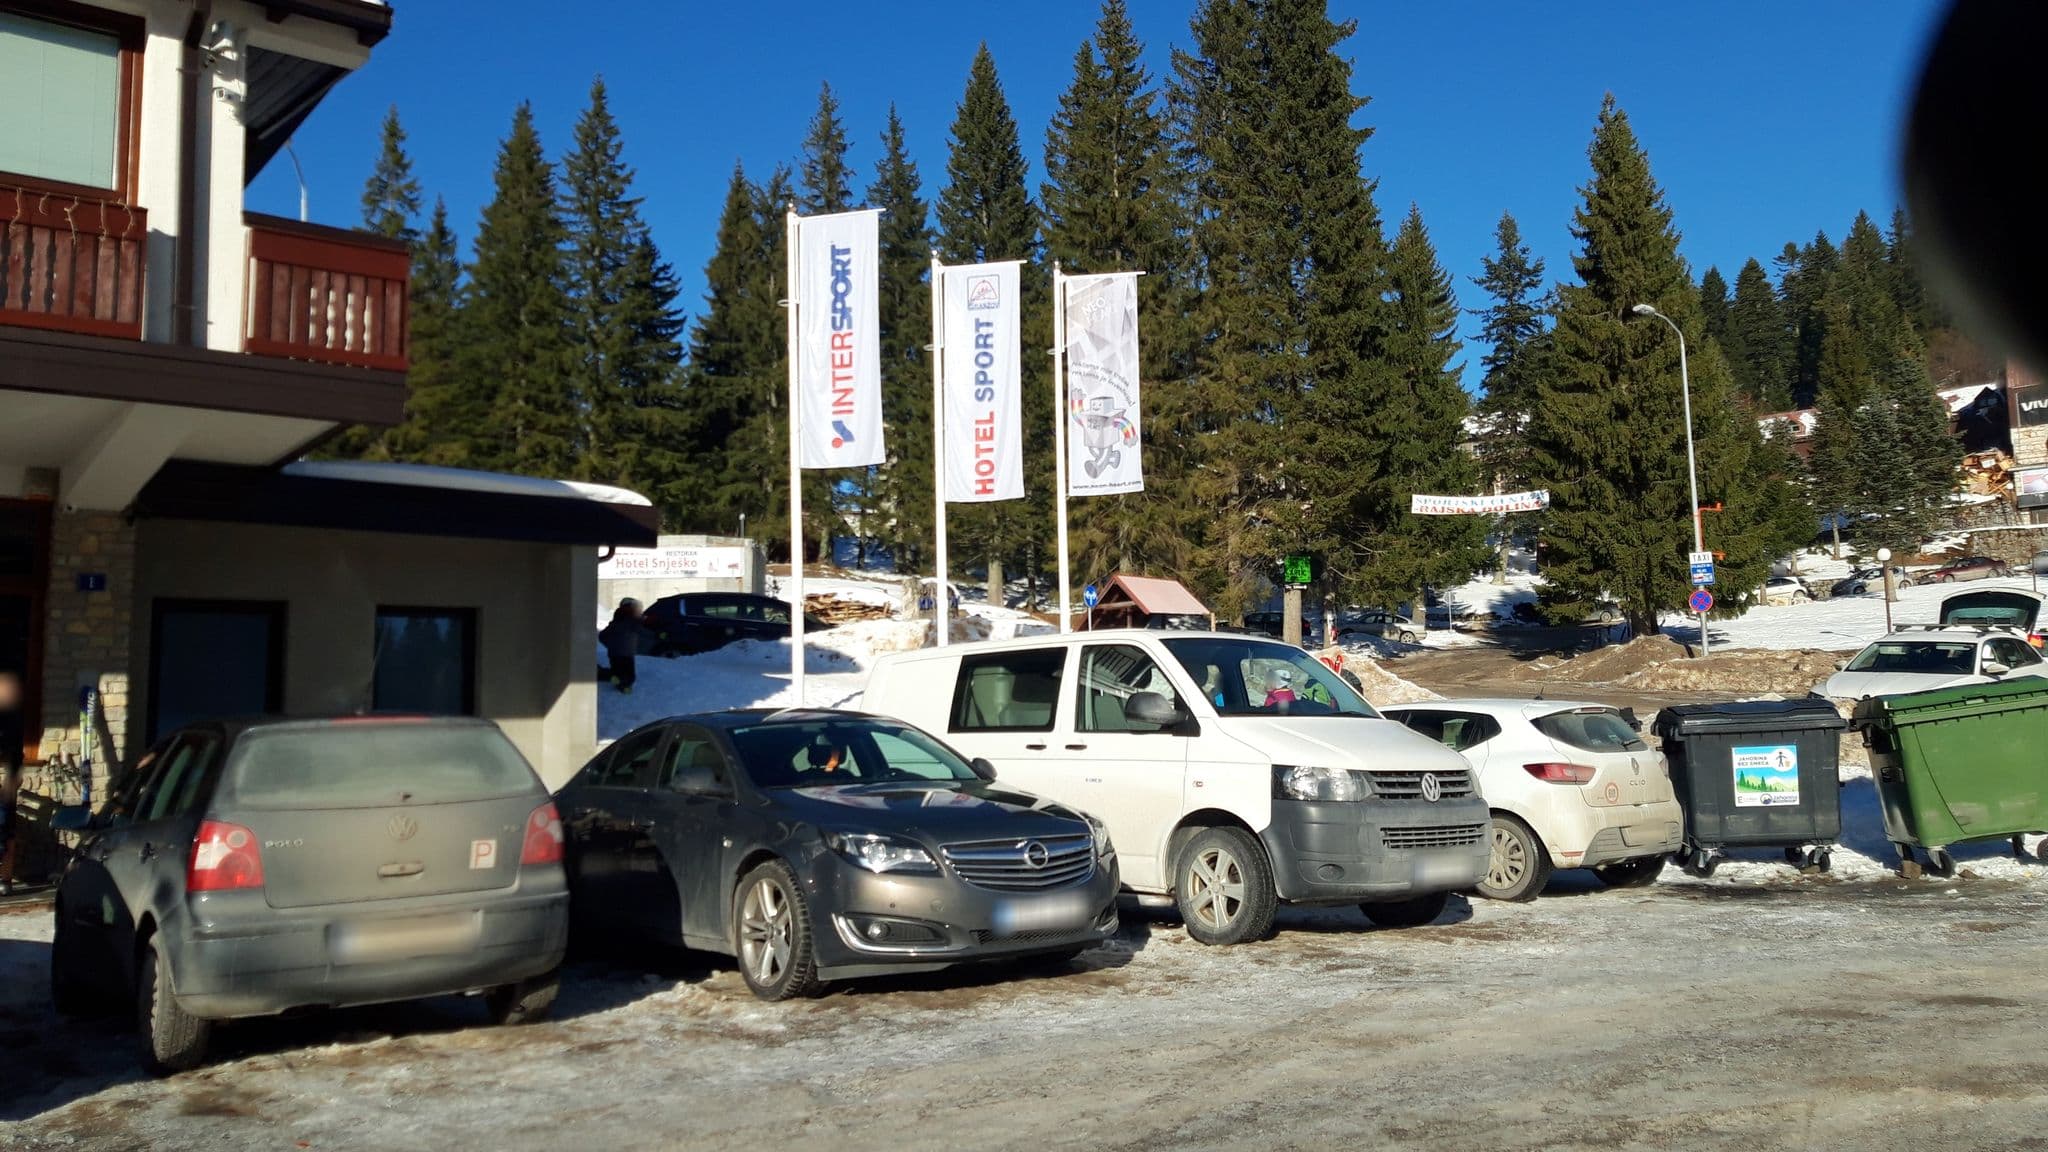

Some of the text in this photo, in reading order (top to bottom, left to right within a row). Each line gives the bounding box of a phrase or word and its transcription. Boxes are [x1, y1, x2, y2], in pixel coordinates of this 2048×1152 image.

[831, 244, 854, 415] INTERSPORT
[975, 318, 994, 402] SPORT
[975, 411, 995, 495] HOTEL
[616, 558, 648, 569] Hotel
[1692, 554, 1710, 562] TAXI
[474, 842, 493, 869] P
